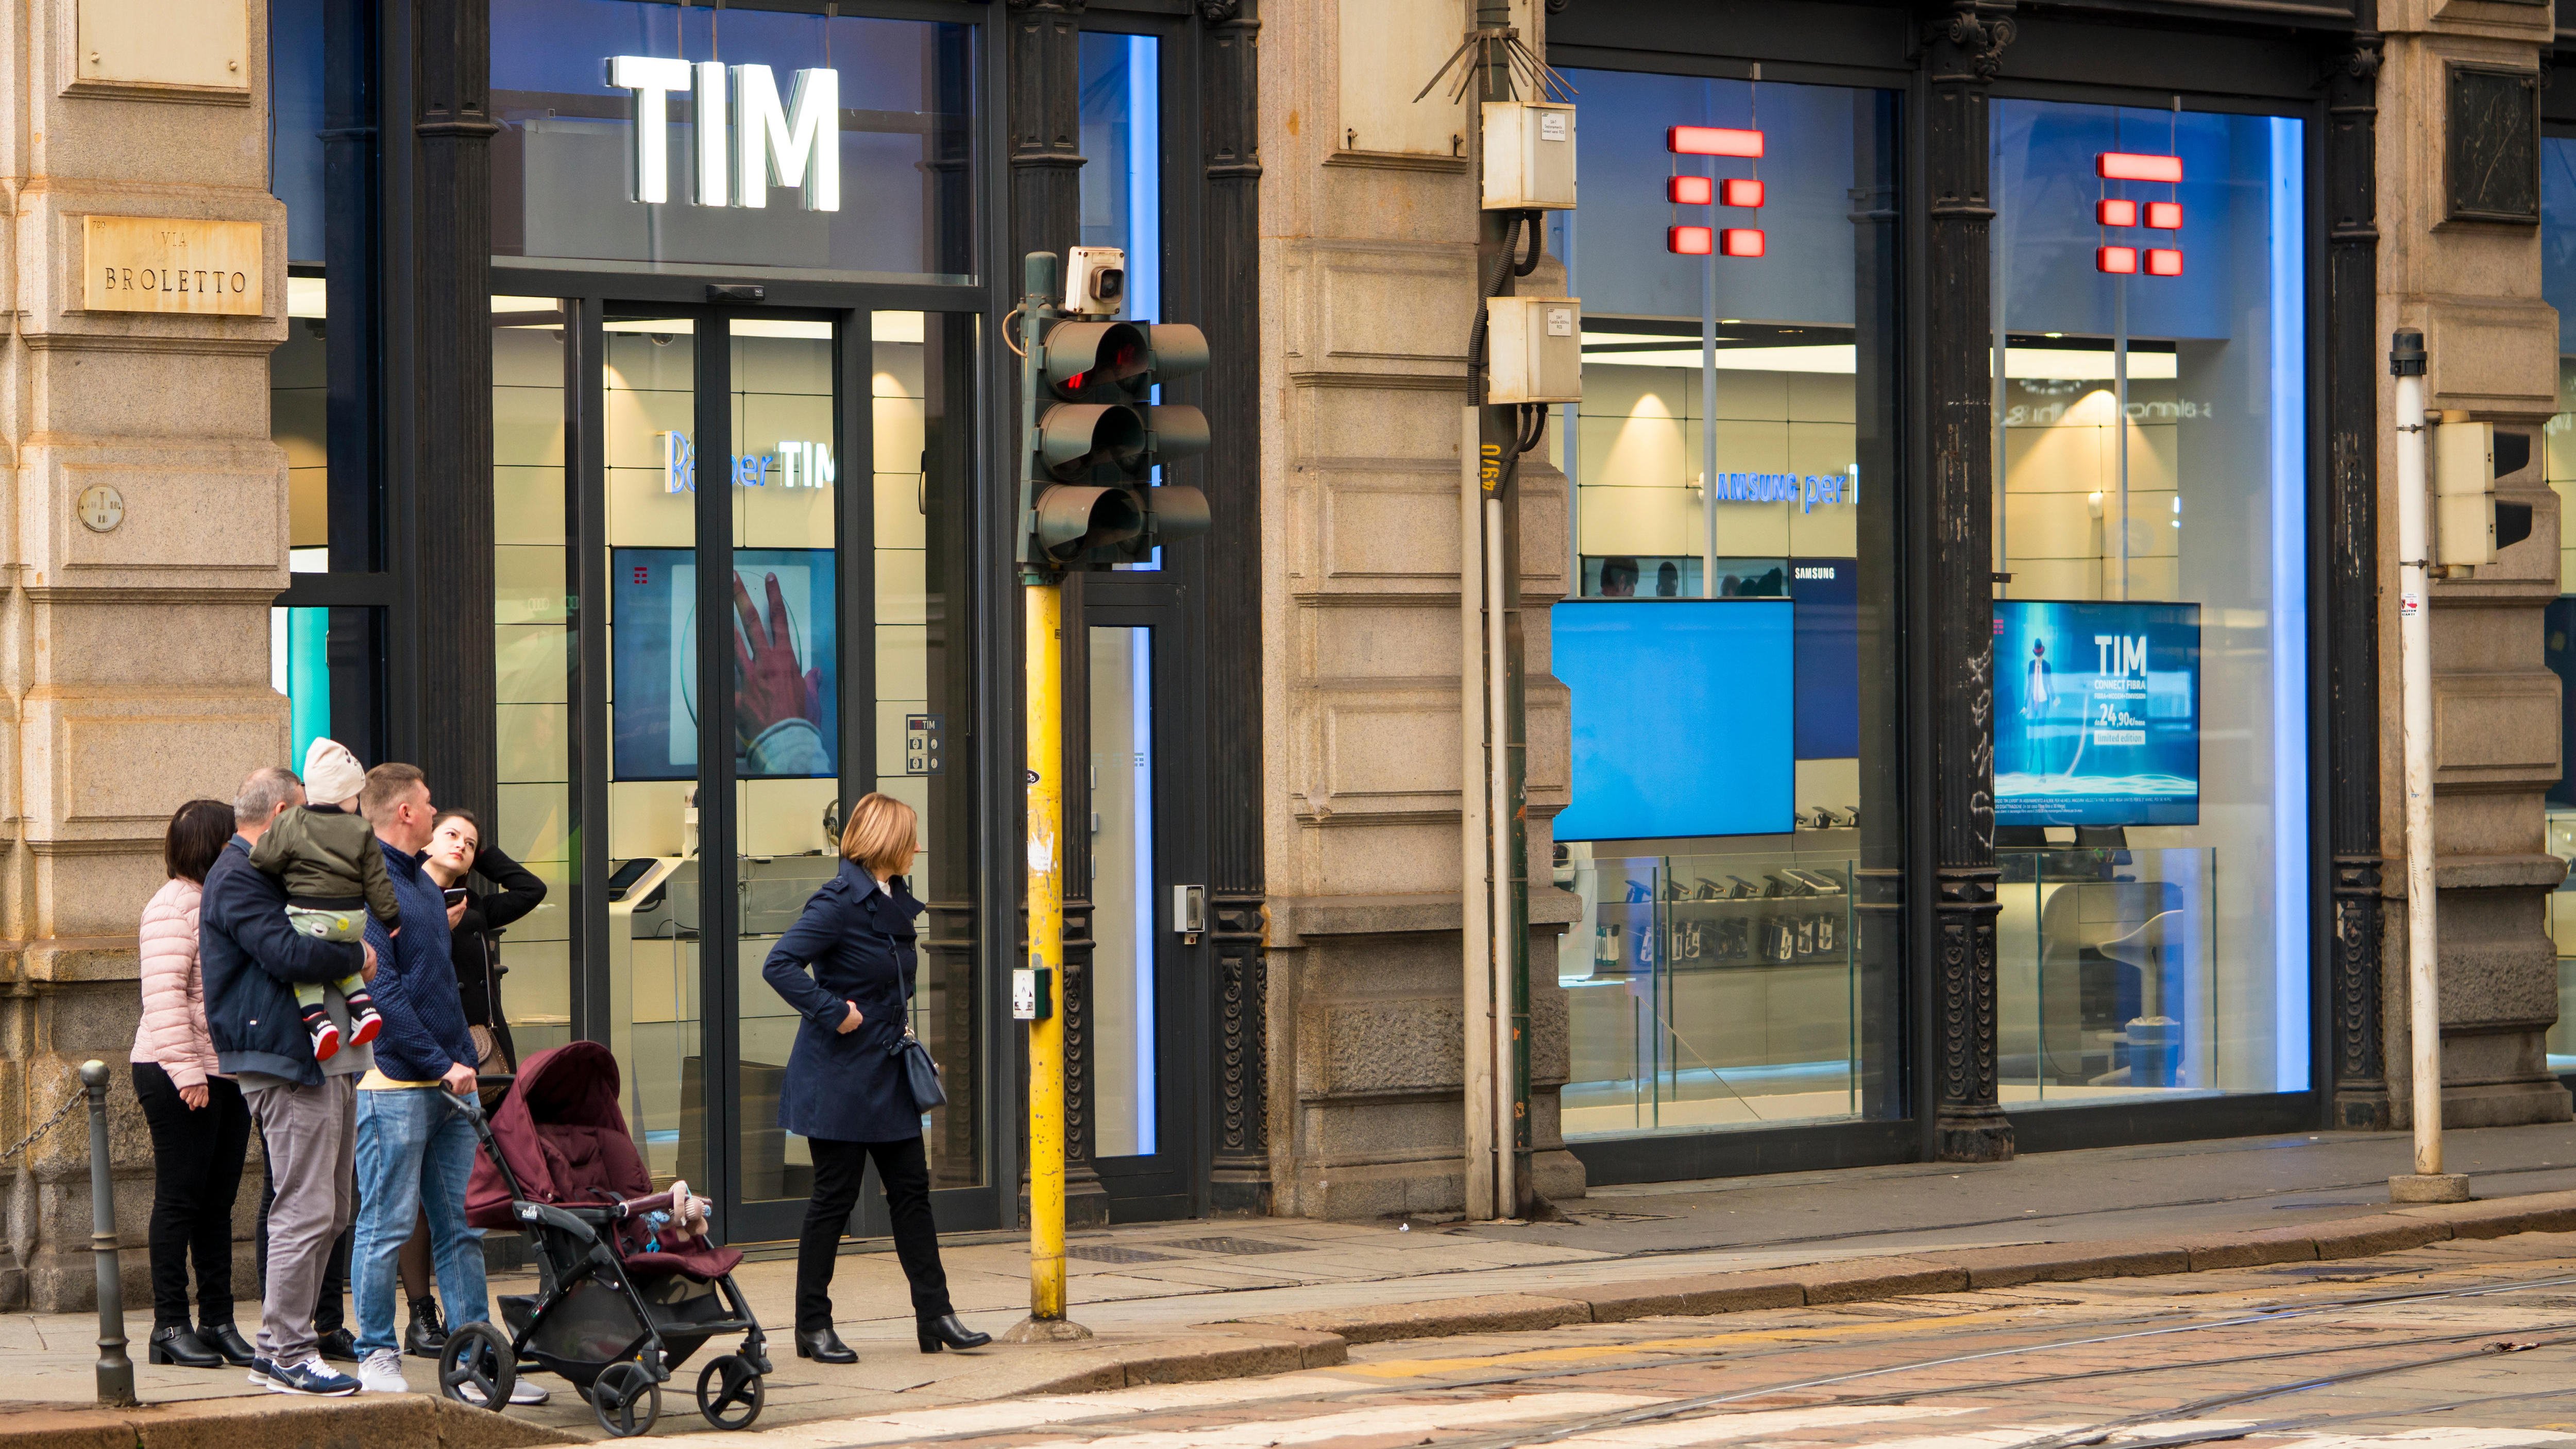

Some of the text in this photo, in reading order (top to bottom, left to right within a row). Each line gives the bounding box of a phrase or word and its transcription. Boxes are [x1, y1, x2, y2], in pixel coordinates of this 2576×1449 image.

[608, 55, 840, 212] TIM
[161, 232, 188, 247] VIA
[105, 267, 246, 293] BROLETTO
[1716, 472, 1798, 502] AMSUNG
[1805, 474, 1846, 514] per
[1795, 567, 1835, 579] SAMSUNG
[2095, 635, 2146, 676] TIM
[2094, 679, 2145, 690] CONNECT FIBRA
[923, 721, 935, 729] TIM
[2098, 734, 2142, 742] limited edition
